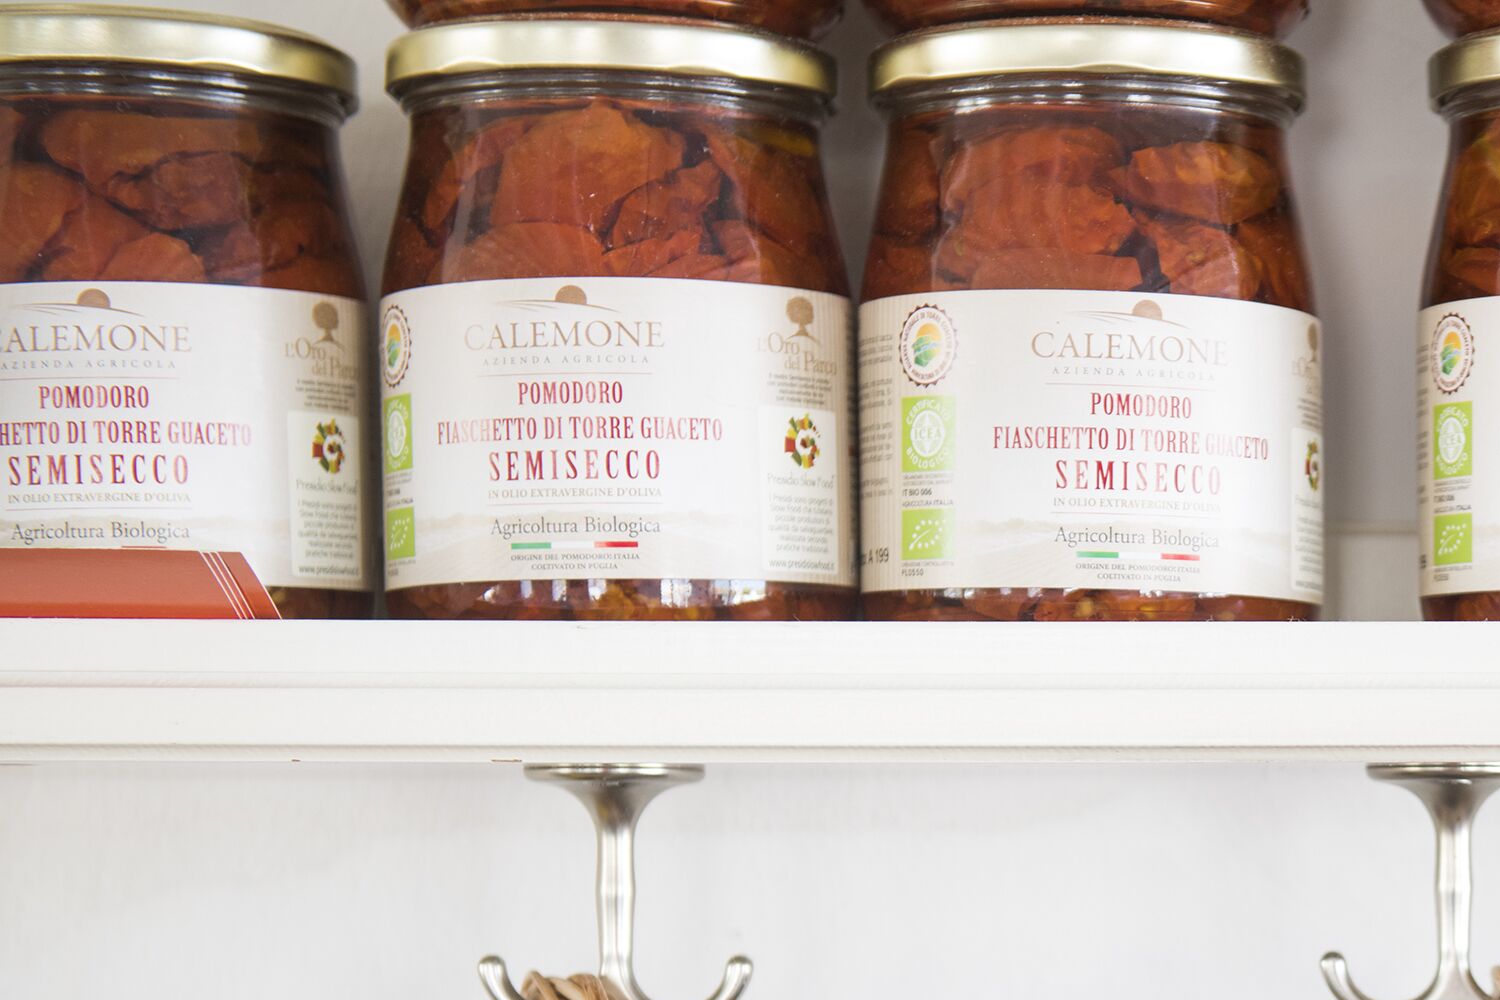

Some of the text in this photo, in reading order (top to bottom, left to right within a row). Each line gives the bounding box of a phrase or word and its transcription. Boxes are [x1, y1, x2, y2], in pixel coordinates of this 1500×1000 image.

[0, 324, 192, 353] ALEMONE
[465, 321, 664, 351] CALEMONE
[1031, 331, 1229, 366] CALEMONE
[1, 360, 176, 370] AZIENDA AGRICOLA
[483, 355, 649, 366] AZIENDA AGRICOLA
[1052, 366, 1214, 380] AZIENDA AGRICOLA
[39, 385, 149, 409] POMODORO
[518, 381, 623, 405] POMODORO
[1091, 393, 1192, 418] POMODORO
[66, 421, 87, 444] DI
[93, 421, 161, 444] TORRE
[168, 422, 252, 446] GUACETO
[438, 416, 722, 444] FIASCHETTO DI TORRE GUACETO
[993, 427, 1268, 460] FIASCHETTO DI TORRE GUACETO
[9, 454, 189, 486] SEMISECCO
[489, 450, 661, 481] SEMISECCO
[1055, 460, 1221, 494] SEMISECCO
[12, 522, 190, 545] Agricoltura Biologica
[491, 516, 661, 539] Agricoltura Biologica
[1054, 526, 1220, 552] Agricoltura Biologica
